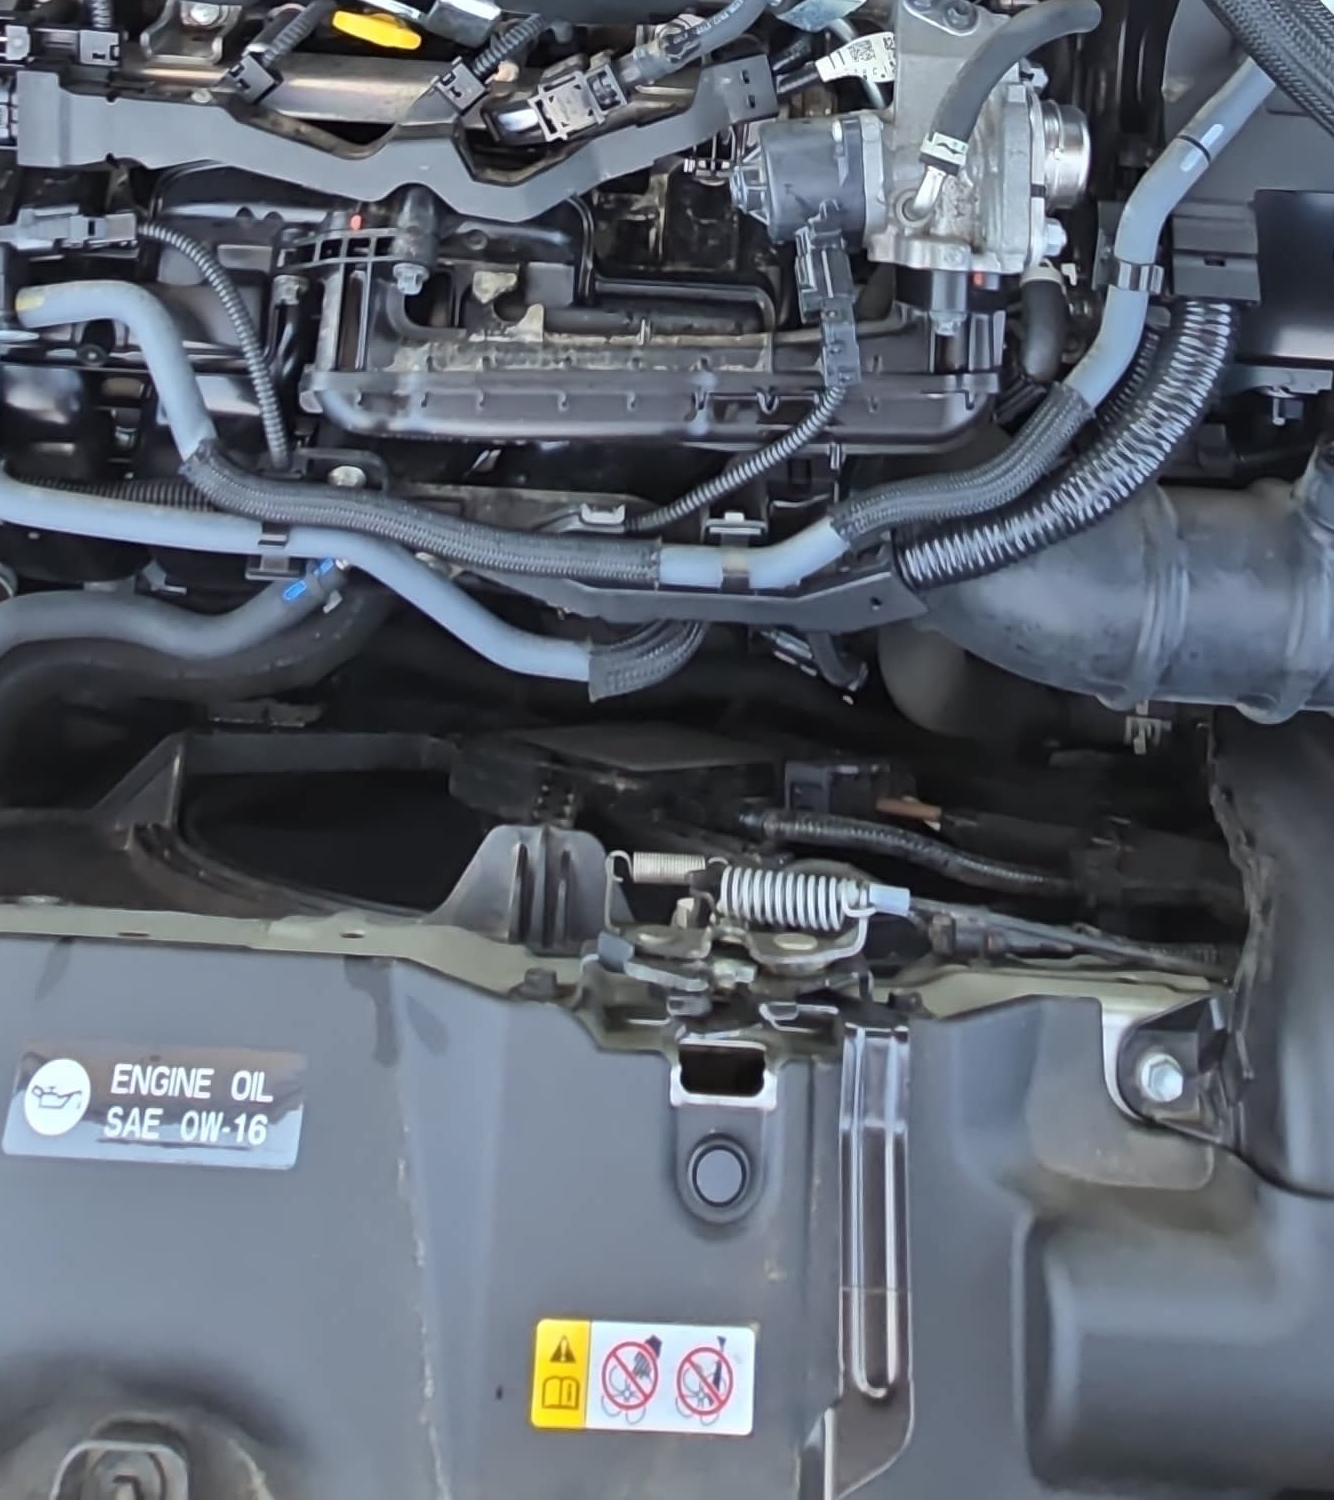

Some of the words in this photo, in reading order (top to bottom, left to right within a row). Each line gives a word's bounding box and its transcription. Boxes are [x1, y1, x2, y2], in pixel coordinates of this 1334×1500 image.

[110, 1063, 215, 1099] ENGINE
[230, 1070, 274, 1103] OIL
[103, 1106, 164, 1140] SAE
